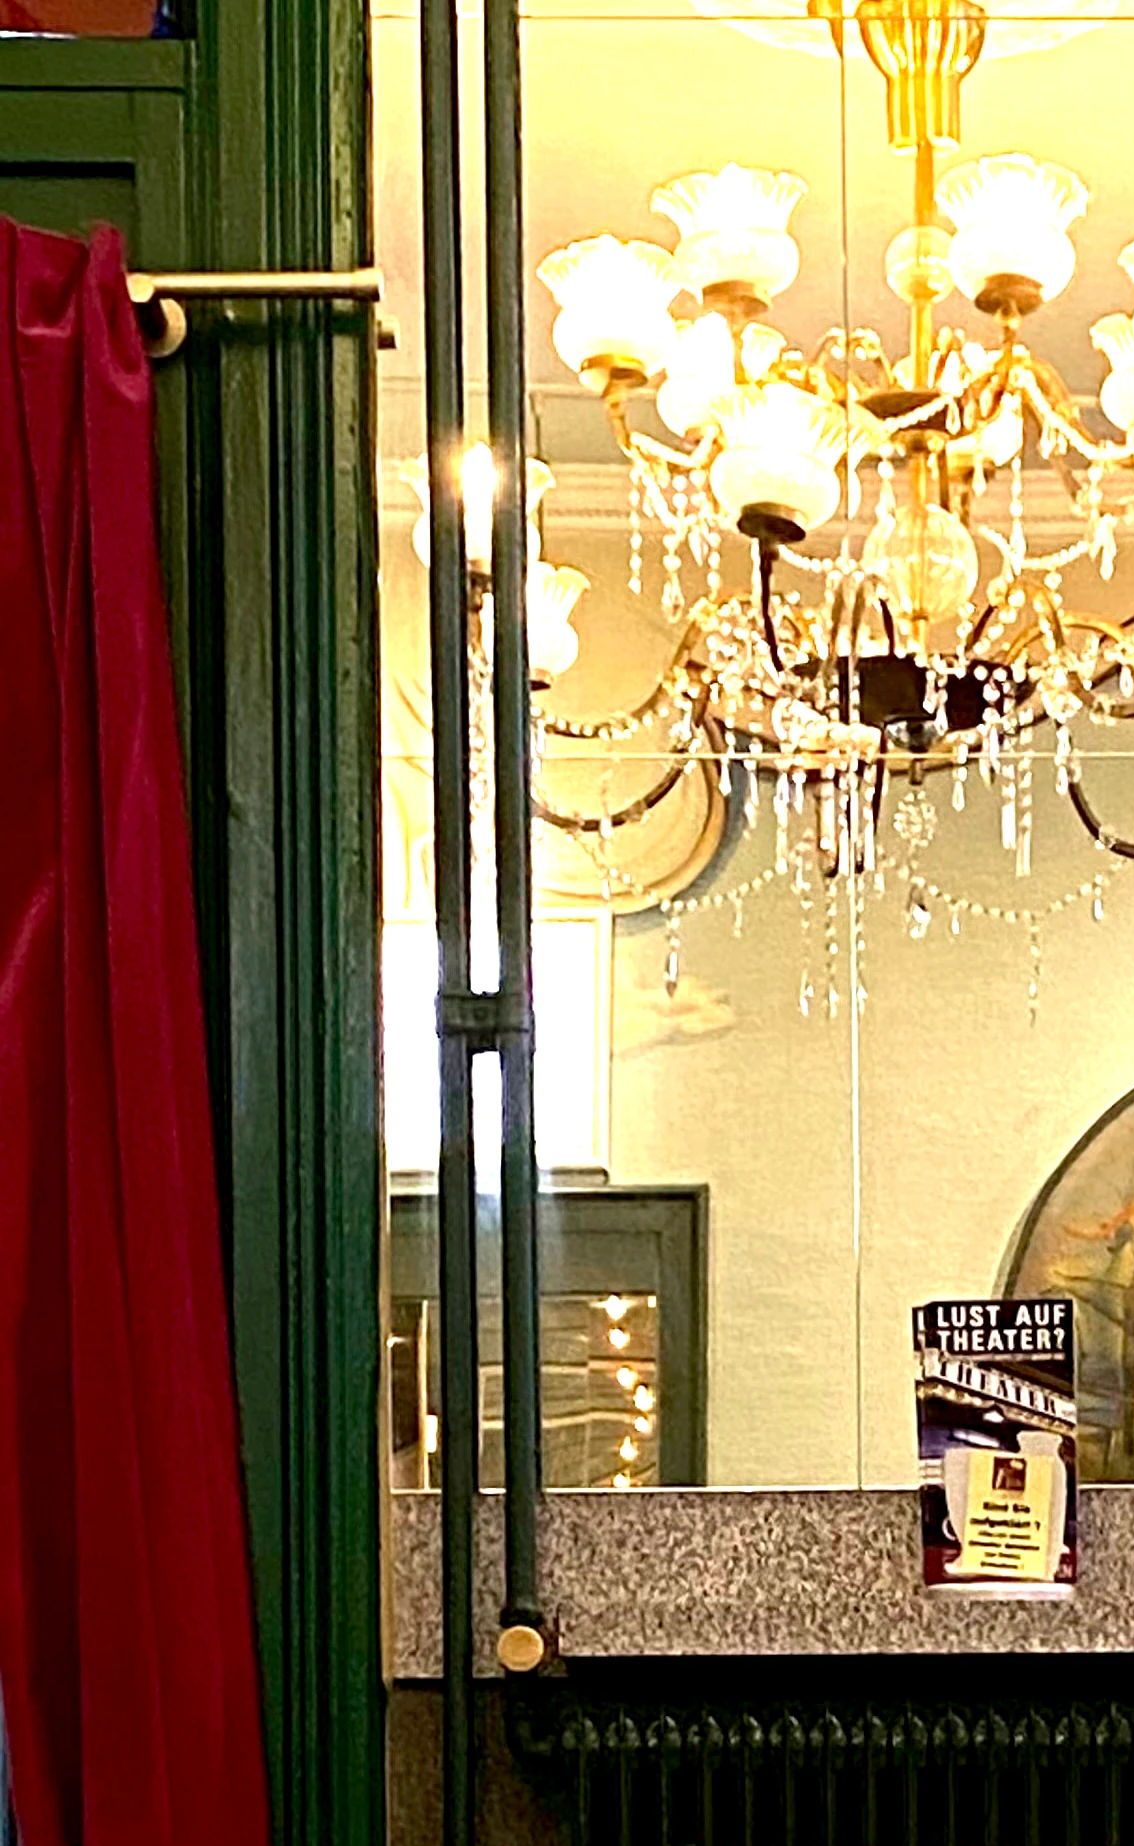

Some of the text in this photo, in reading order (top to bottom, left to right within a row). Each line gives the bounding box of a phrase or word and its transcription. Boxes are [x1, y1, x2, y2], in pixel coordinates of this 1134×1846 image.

[936, 1305, 1001, 1328] LUST
[1015, 1303, 1066, 1326] AUF
[936, 1328, 1066, 1351] THEATER?
